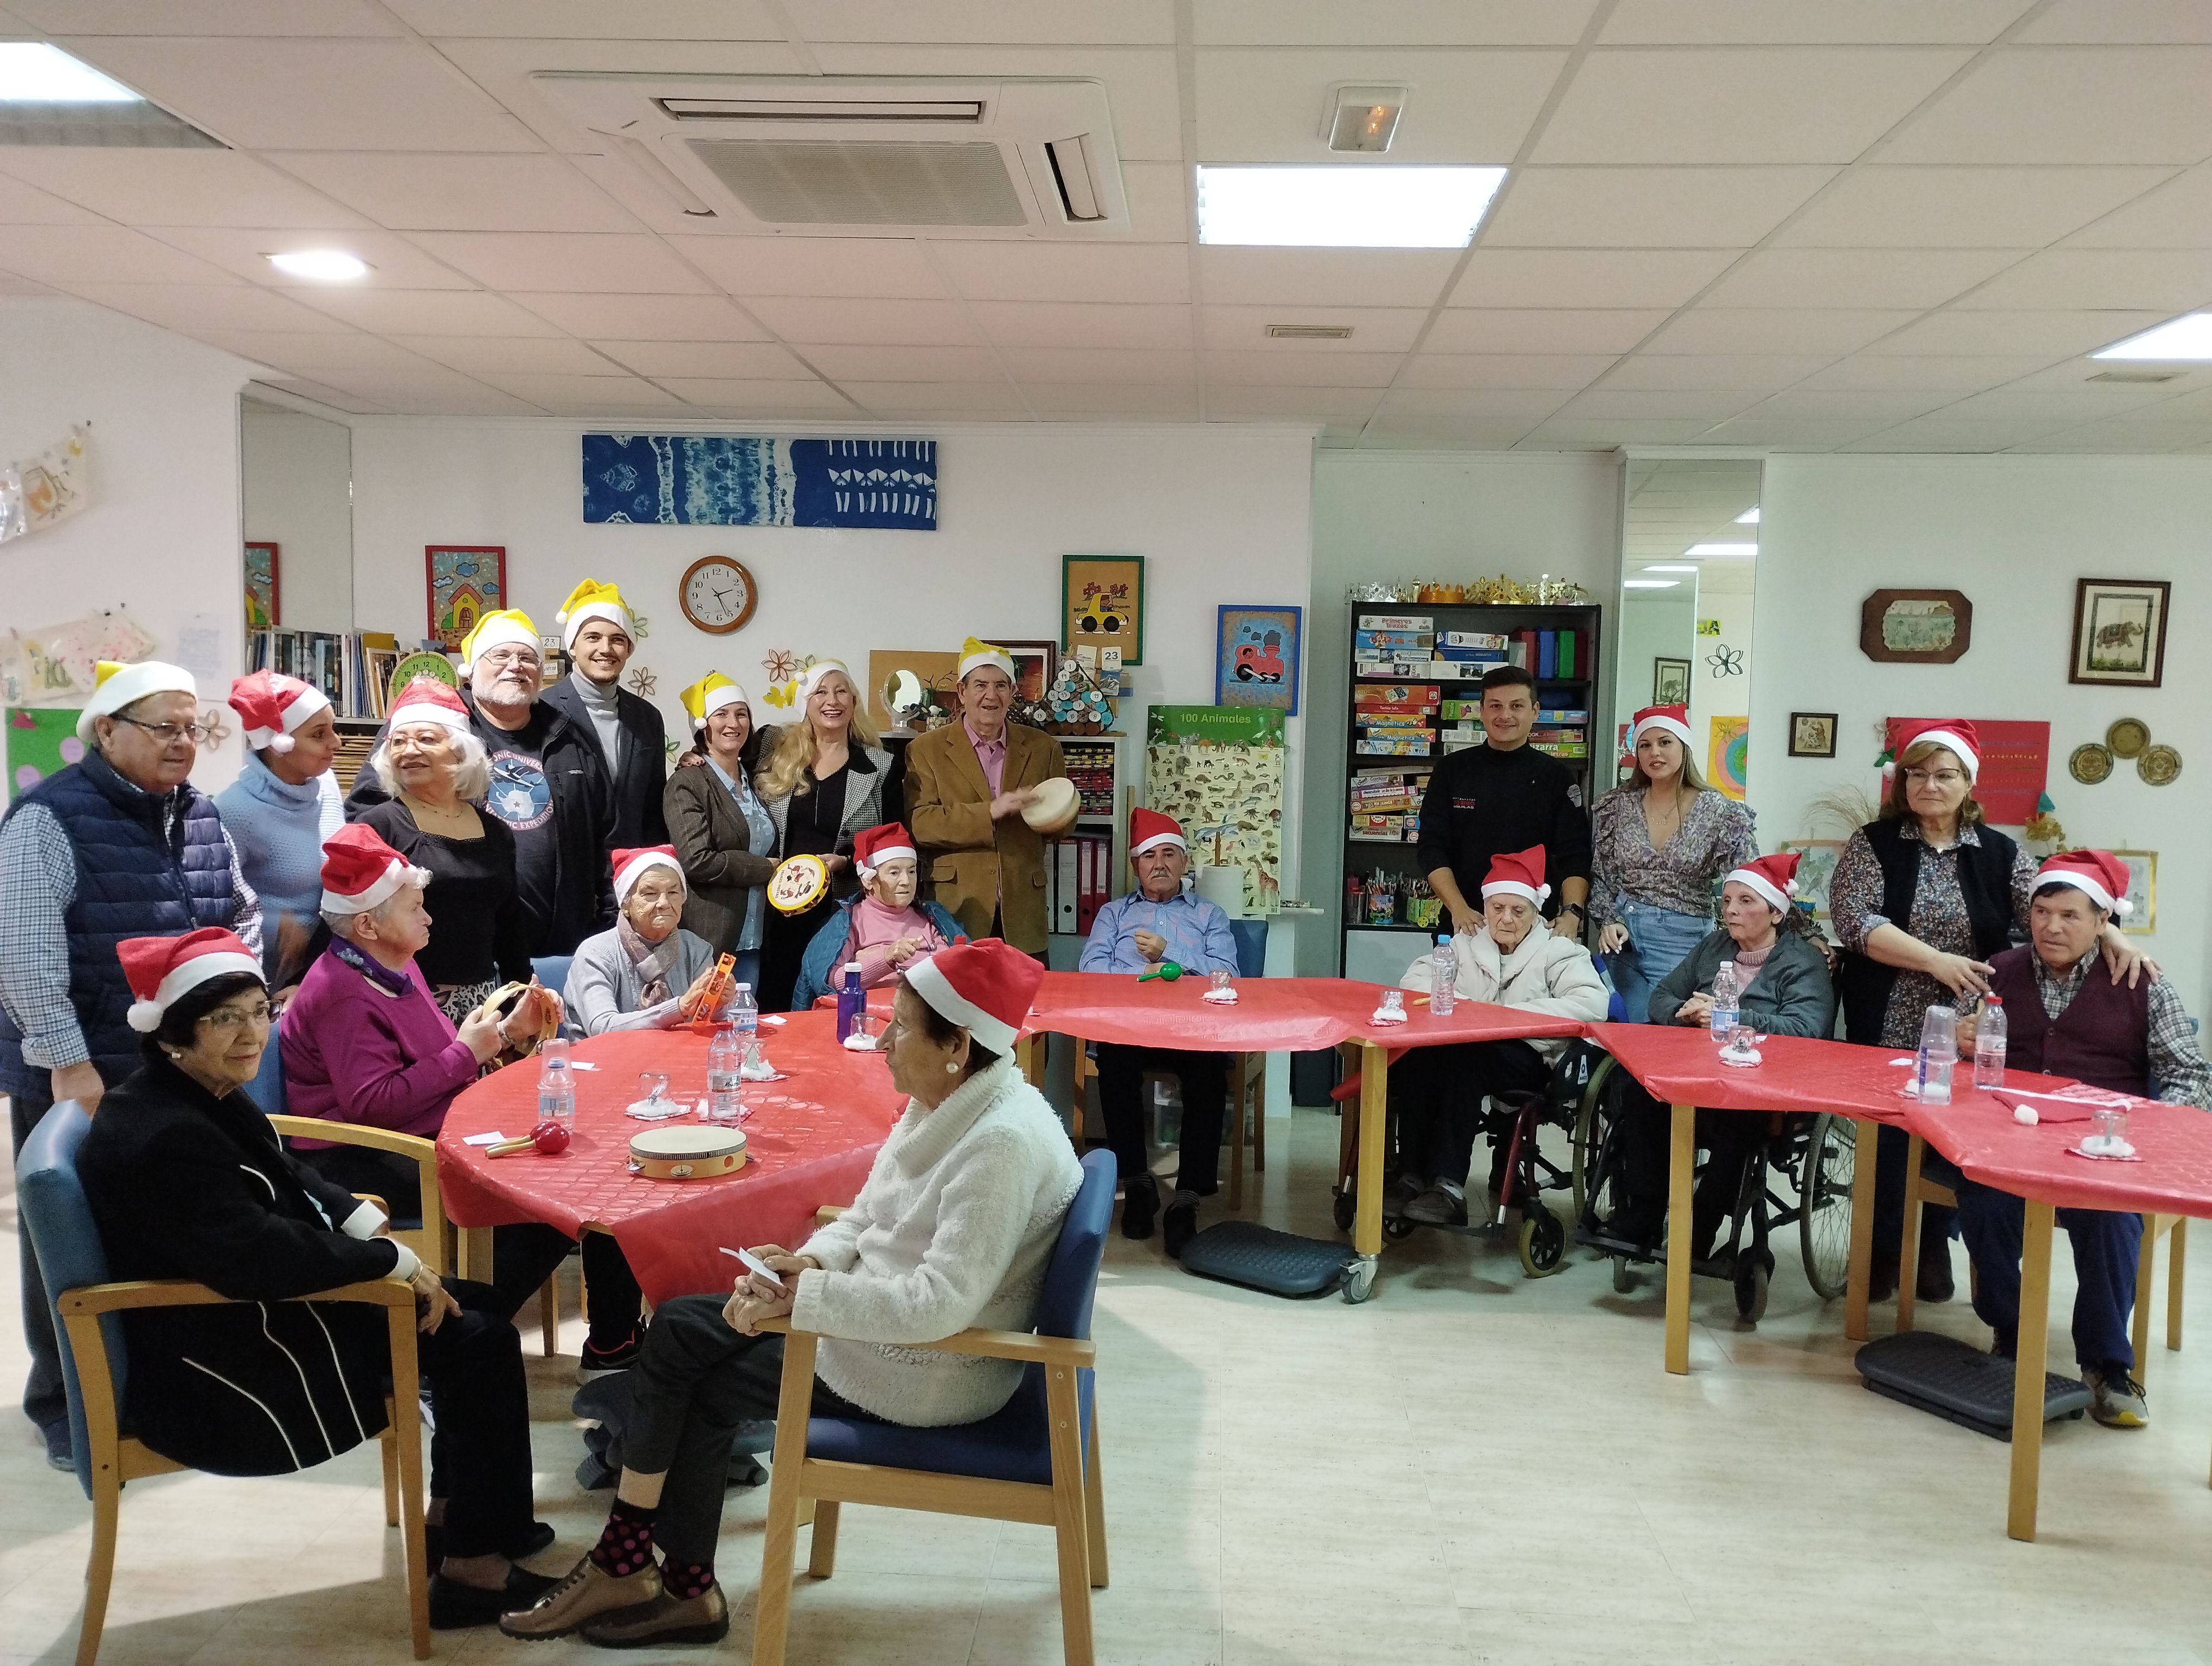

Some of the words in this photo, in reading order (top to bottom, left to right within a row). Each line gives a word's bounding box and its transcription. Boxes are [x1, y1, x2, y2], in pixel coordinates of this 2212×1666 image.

[544, 638, 555, 647] 23
[1104, 651, 1118, 660] 23
[1181, 714, 1198, 722] 100
[1201, 714, 1251, 723] Animales
[513, 754, 543, 772] UNIVERS
